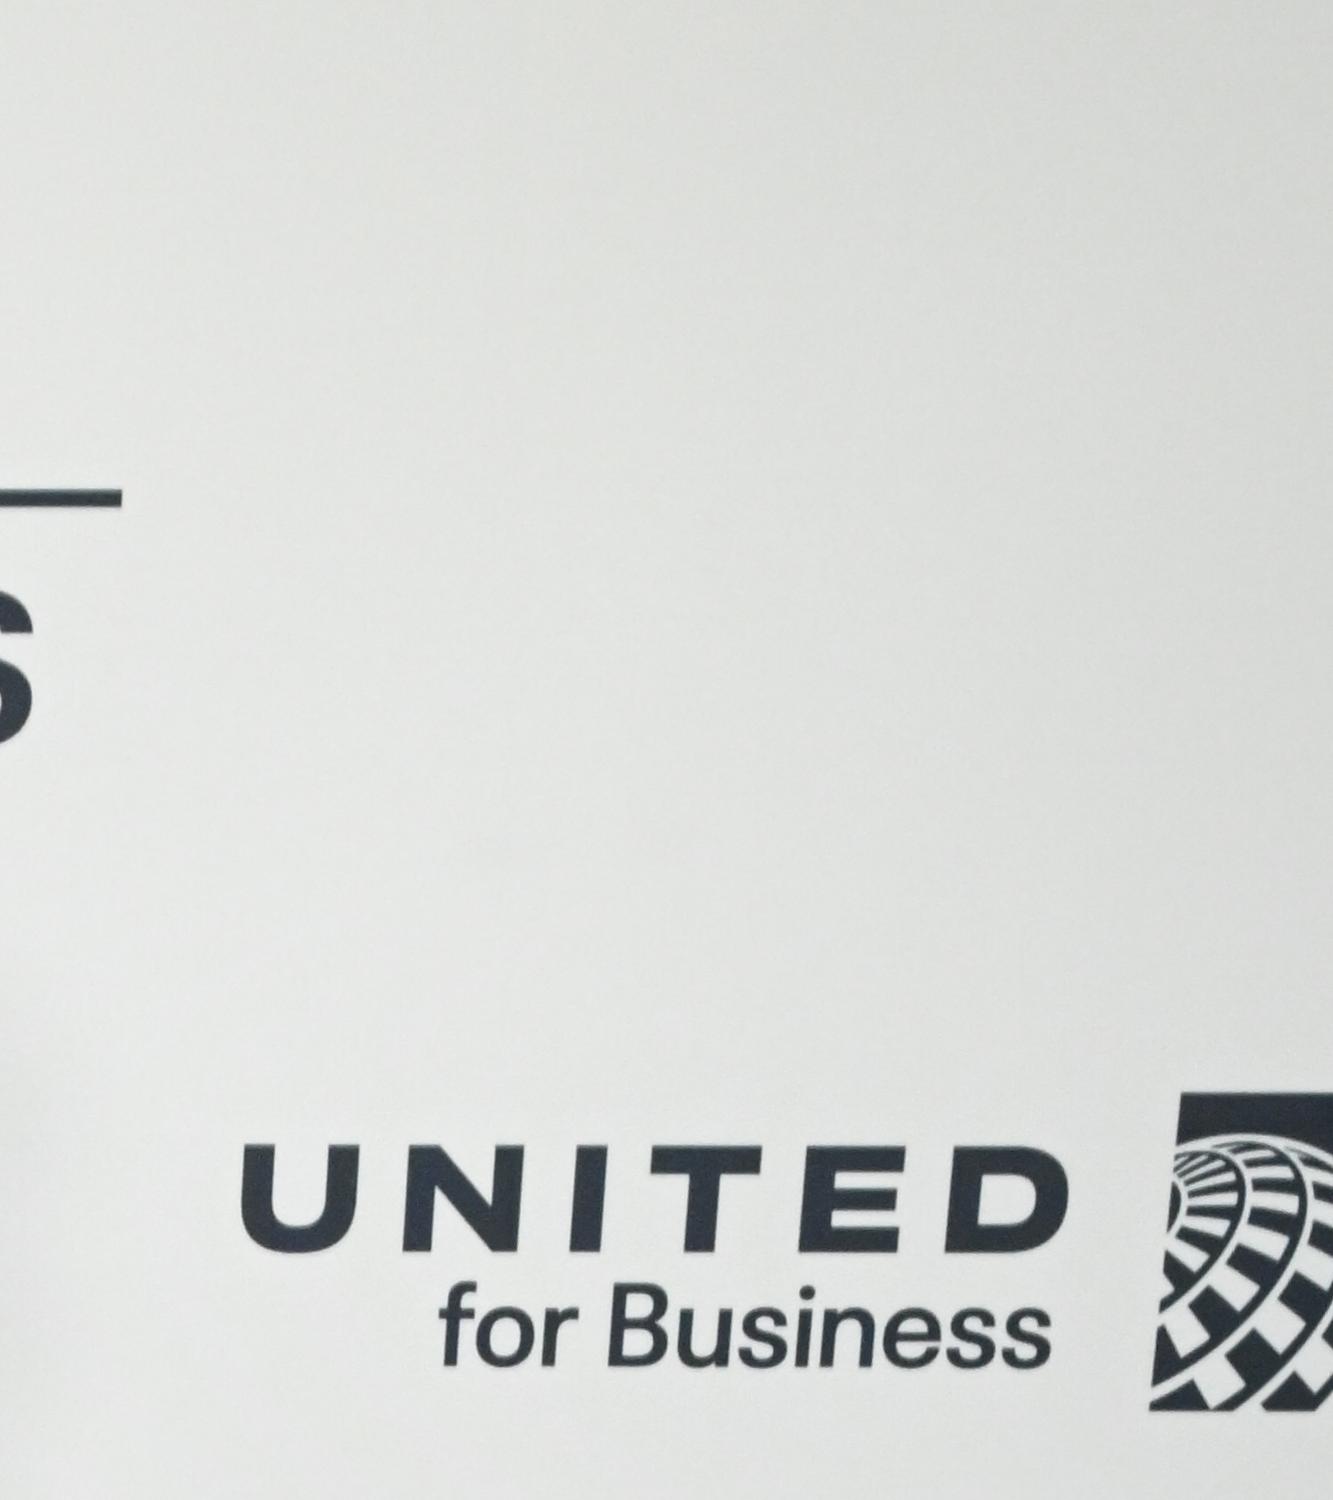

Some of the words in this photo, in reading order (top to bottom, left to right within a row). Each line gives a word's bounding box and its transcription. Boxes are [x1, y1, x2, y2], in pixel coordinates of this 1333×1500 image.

[240, 1144, 1071, 1255] UNITED
[438, 1281, 579, 1368] for
[607, 1282, 1052, 1370] Business
